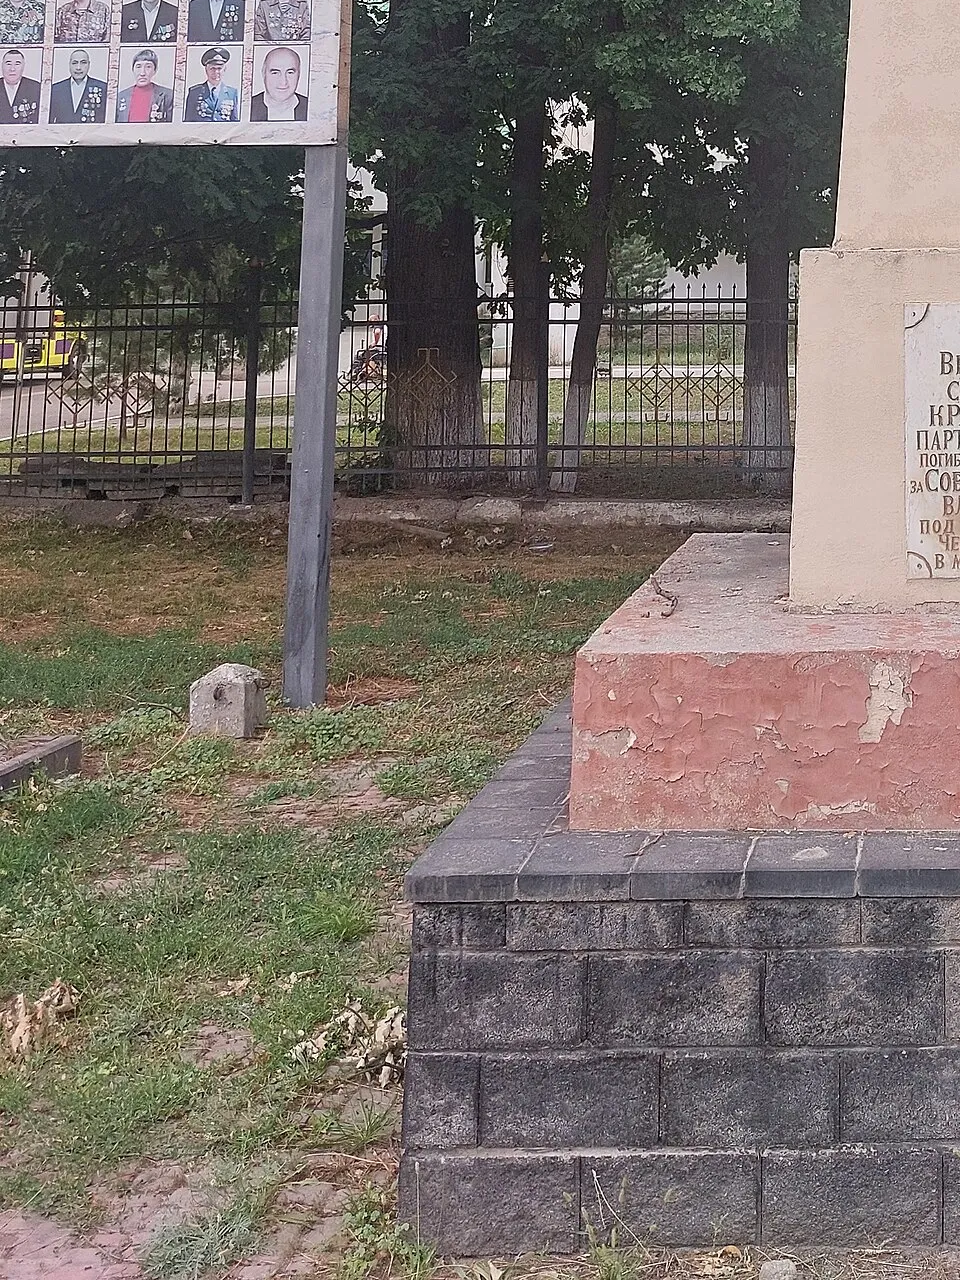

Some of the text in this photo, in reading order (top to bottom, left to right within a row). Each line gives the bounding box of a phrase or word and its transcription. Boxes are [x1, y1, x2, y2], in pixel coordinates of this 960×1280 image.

[910, 480, 924, 494] ЗА
[920, 519, 955, 535] ПОД
[934, 553, 945, 570] В
